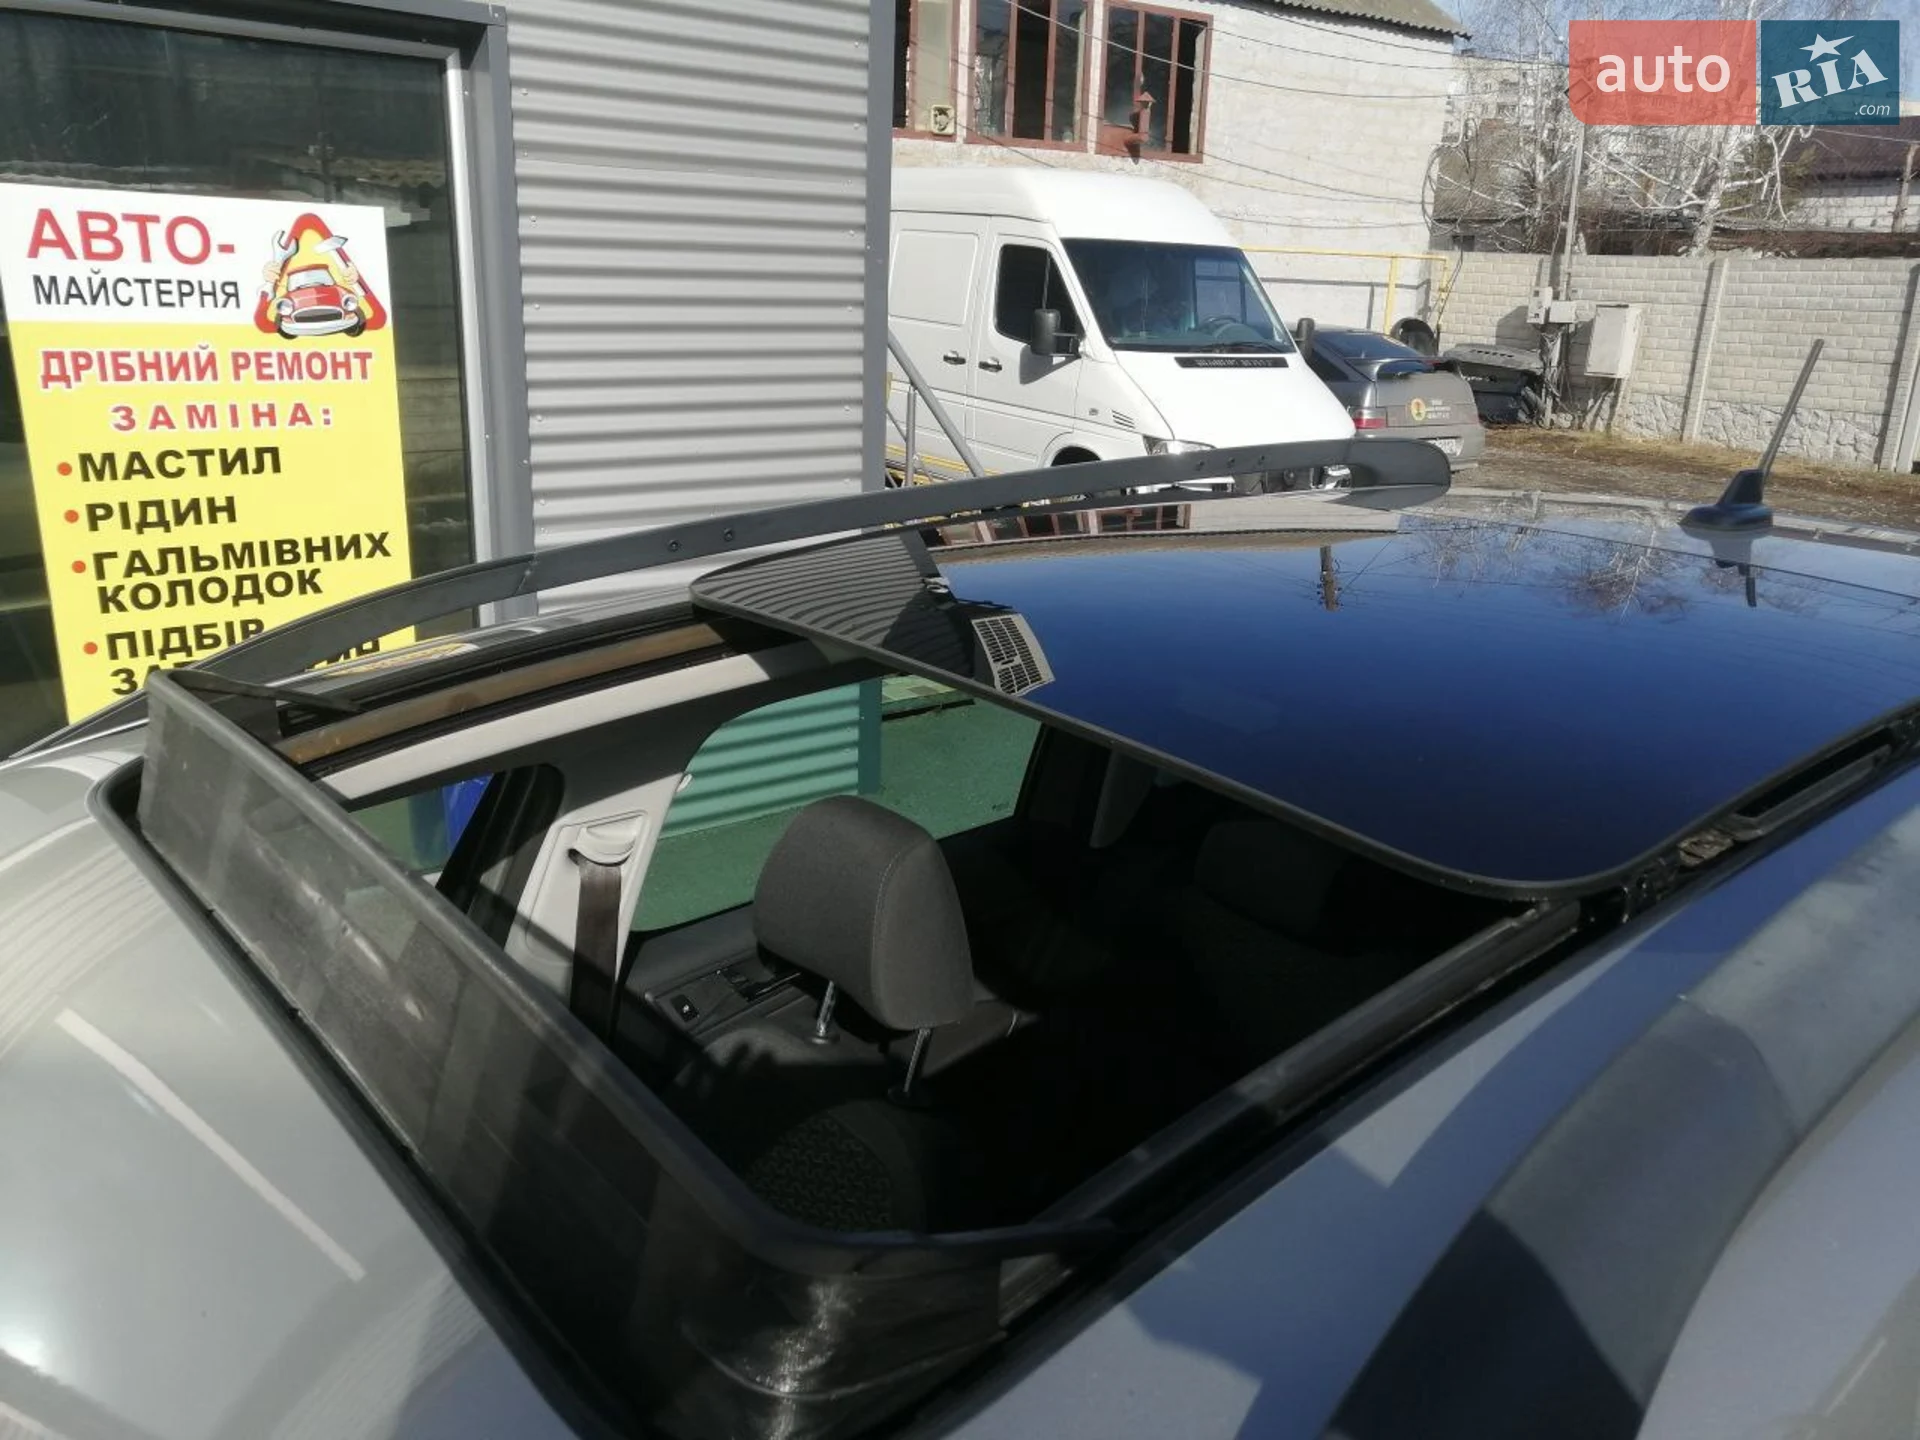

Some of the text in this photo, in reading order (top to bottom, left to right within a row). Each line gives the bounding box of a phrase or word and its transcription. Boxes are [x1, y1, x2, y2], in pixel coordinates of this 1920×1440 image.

[27, 207, 236, 265] АВТО-
[33, 267, 241, 309] МАЙСТЕРНЯ
[41, 344, 373, 389] ДРІБНИЙ РЕМОНТ
[111, 402, 333, 431] ЗАМІНА:
[77, 446, 282, 482] МАСТИЛ
[86, 496, 237, 534] РІДИН
[92, 531, 392, 580] ГАЛЬМІВНИХ
[98, 568, 323, 614] КОЛОДОК
